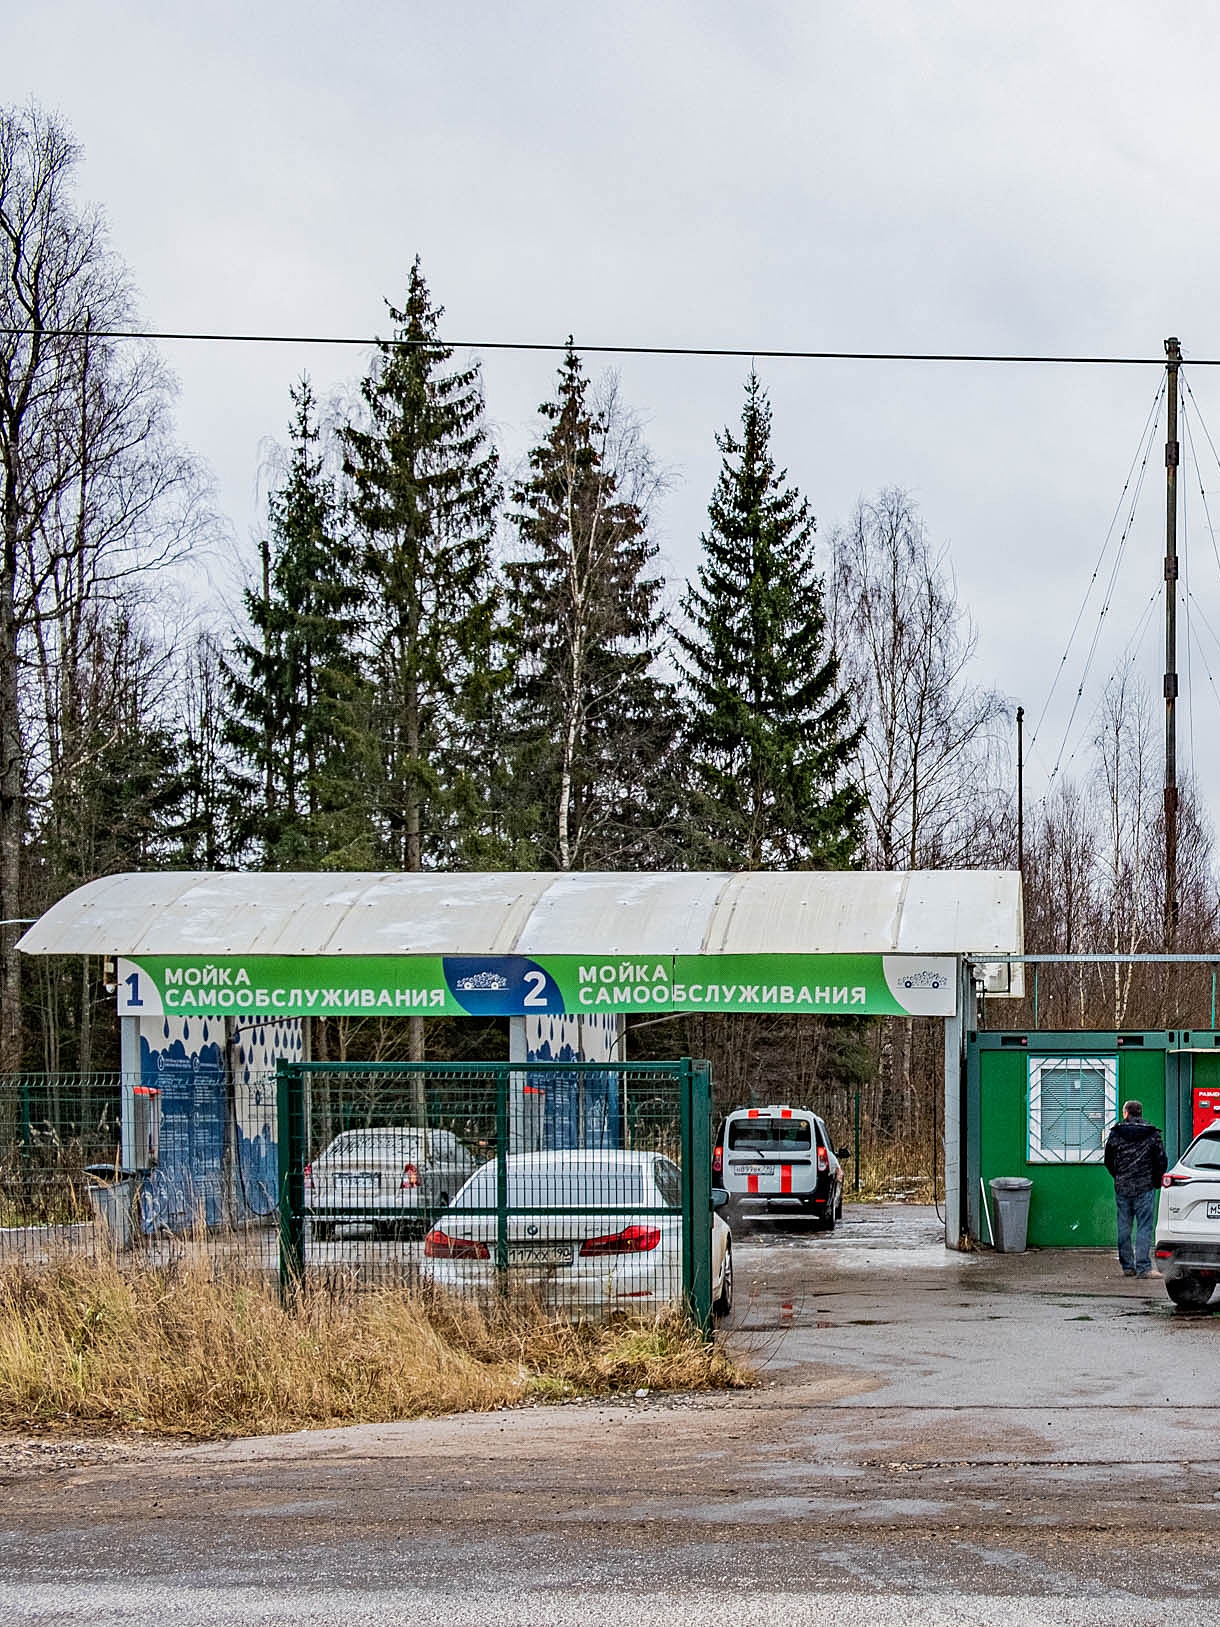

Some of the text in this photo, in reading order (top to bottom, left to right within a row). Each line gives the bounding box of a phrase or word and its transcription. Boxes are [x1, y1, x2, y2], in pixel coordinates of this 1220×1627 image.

[165, 965, 250, 985] МОЙКА
[579, 963, 668, 983] МОЙКА
[125, 973, 143, 1006] 1
[165, 989, 444, 1006] САМООБСЛУЖИВАНИЯ
[523, 971, 547, 1006] 2
[579, 985, 865, 1004] САМООБСЛУЖИВАНИЯ
